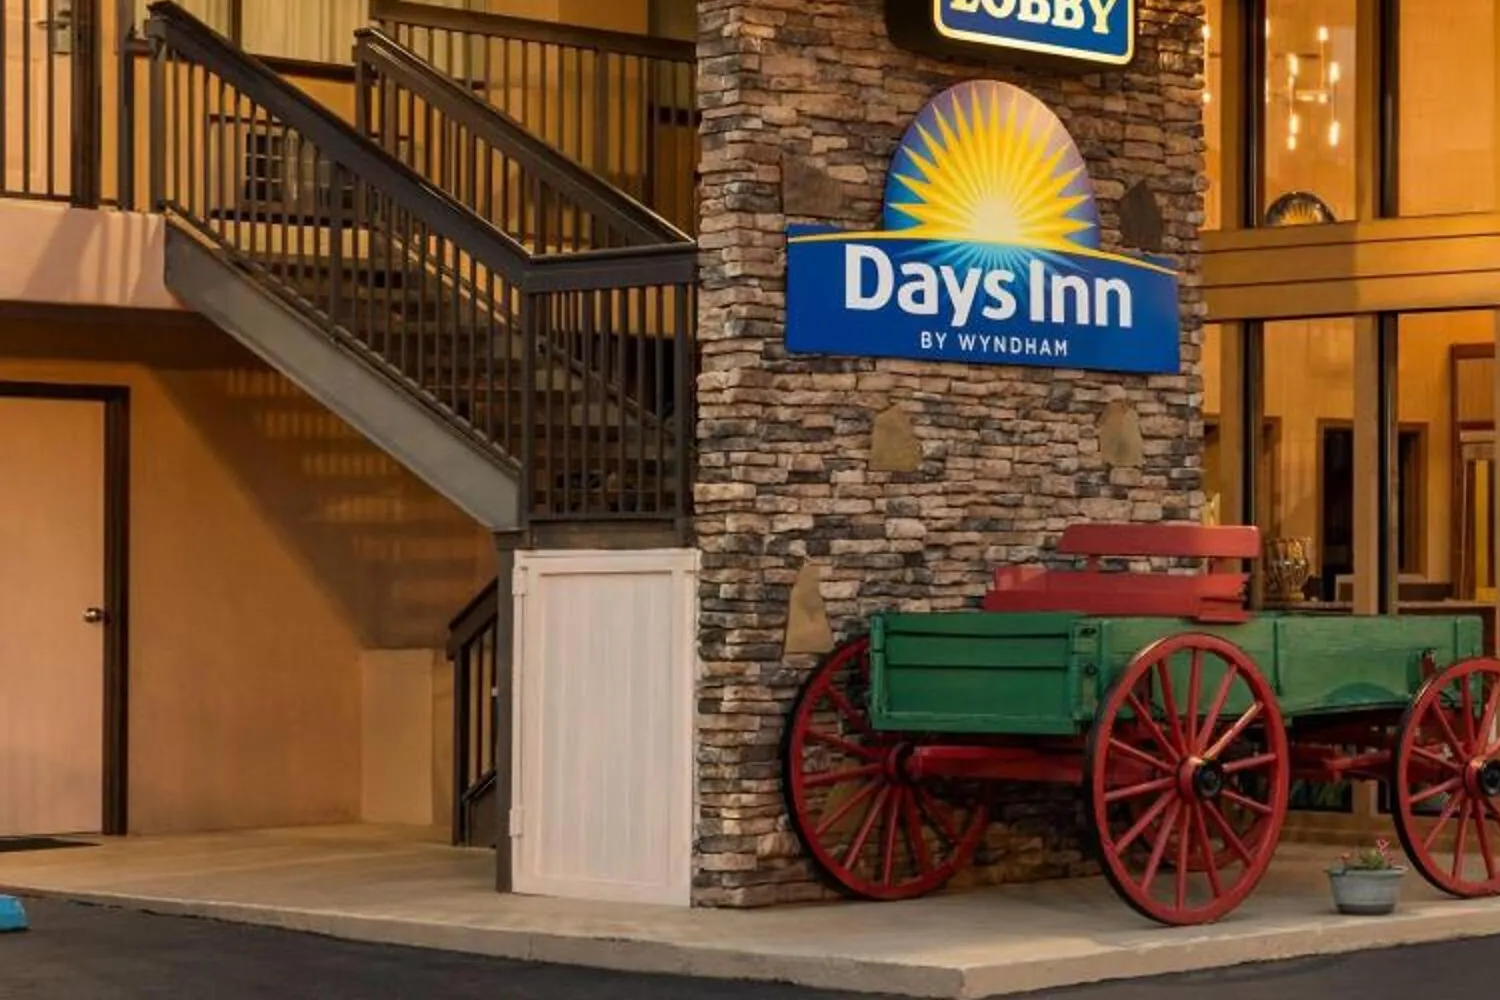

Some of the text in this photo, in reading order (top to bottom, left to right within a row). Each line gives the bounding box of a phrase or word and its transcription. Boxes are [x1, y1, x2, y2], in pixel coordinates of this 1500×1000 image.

[845, 243, 1133, 329] Days Inn
[920, 331, 1068, 357] BY WYNDHAM
